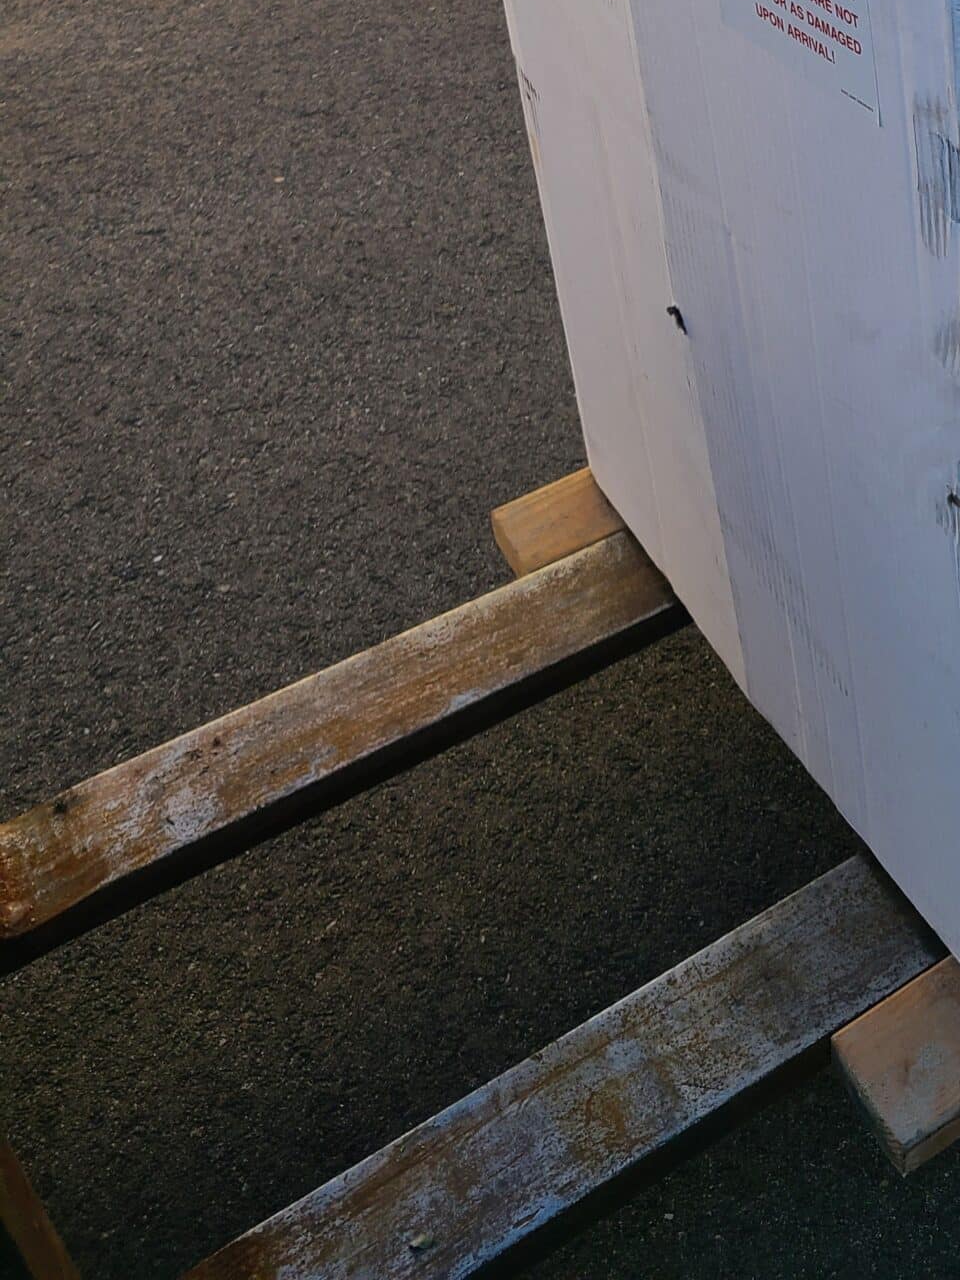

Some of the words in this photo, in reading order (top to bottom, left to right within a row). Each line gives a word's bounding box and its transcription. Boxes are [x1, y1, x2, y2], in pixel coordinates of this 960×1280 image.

[755, 3, 784, 32] UPON
[788, 24, 835, 64] ARRIVAL!
[790, 2, 804, 20] AS
[807, 11, 862, 55] DAMAGED
[835, 3, 858, 28] NOT
